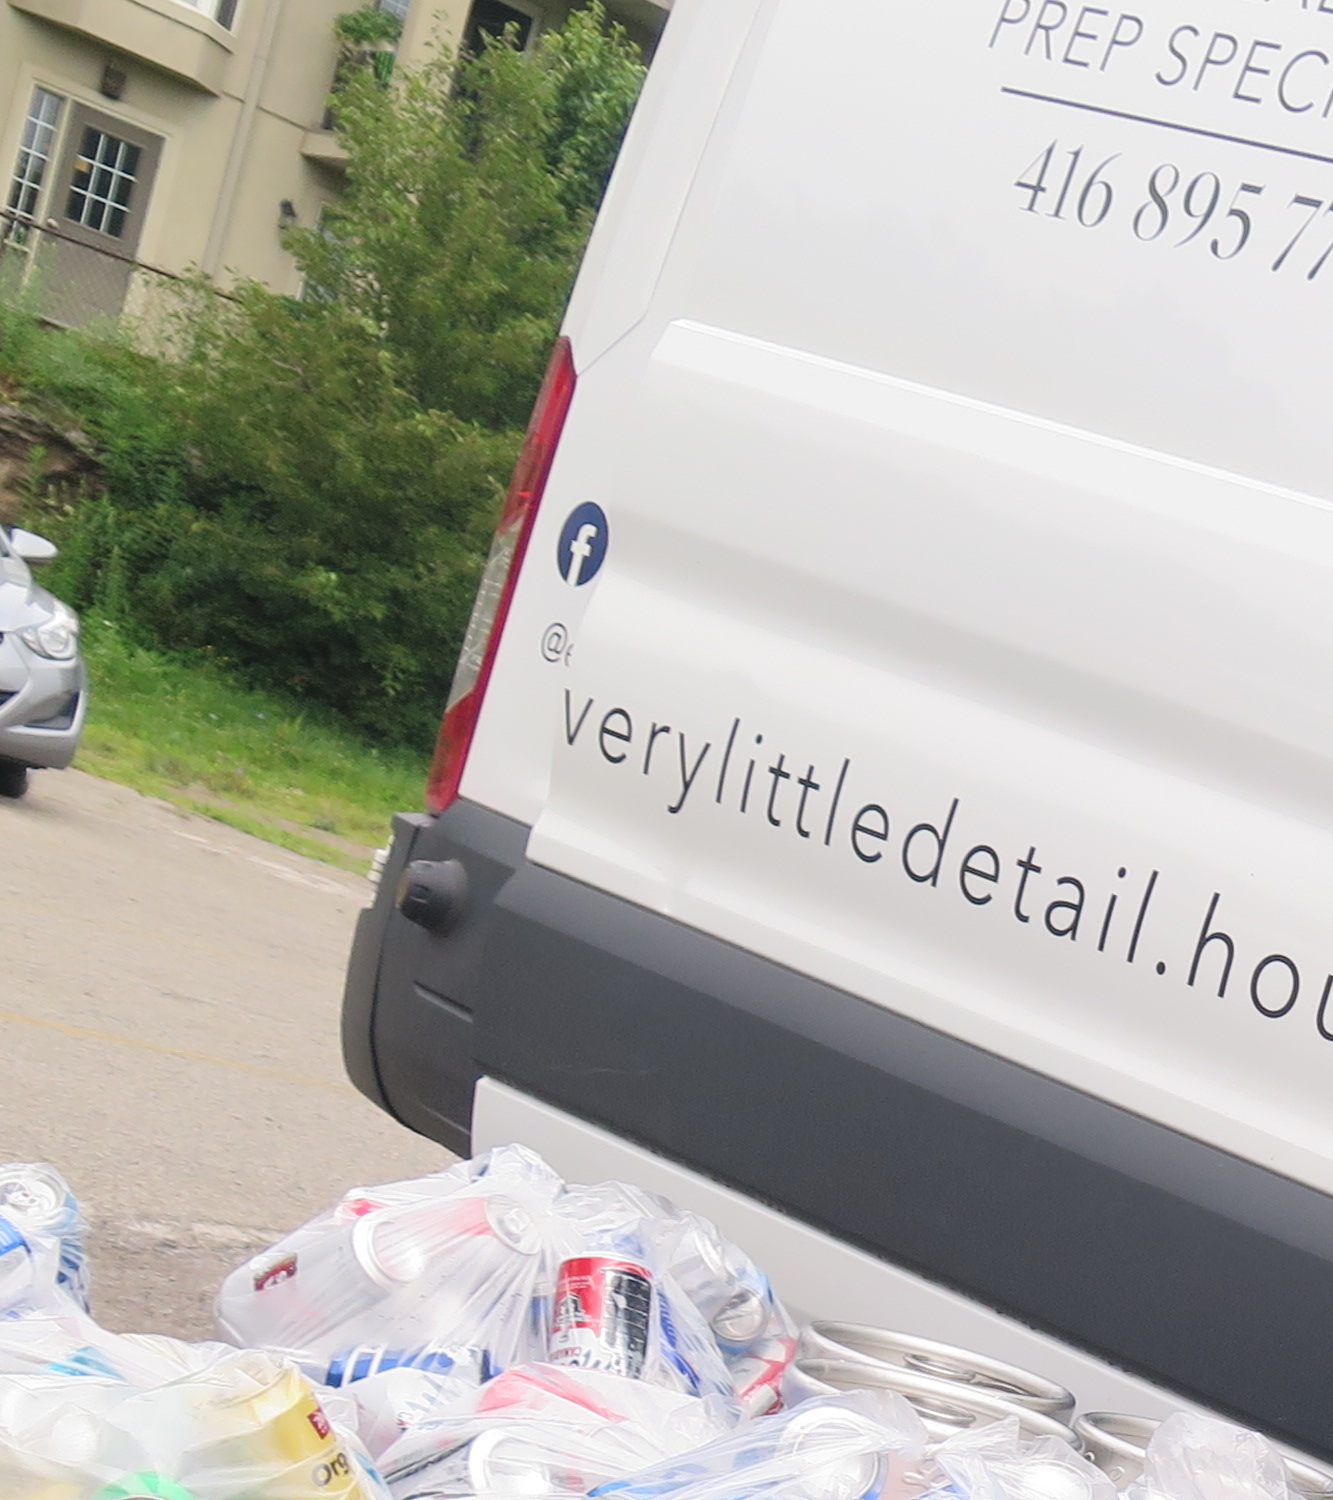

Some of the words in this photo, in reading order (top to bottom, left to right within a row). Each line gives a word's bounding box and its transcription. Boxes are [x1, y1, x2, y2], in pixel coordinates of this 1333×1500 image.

[987, 0, 1144, 72] PREP
[1013, 138, 1123, 228] 416
[1132, 163, 1267, 260] 895
